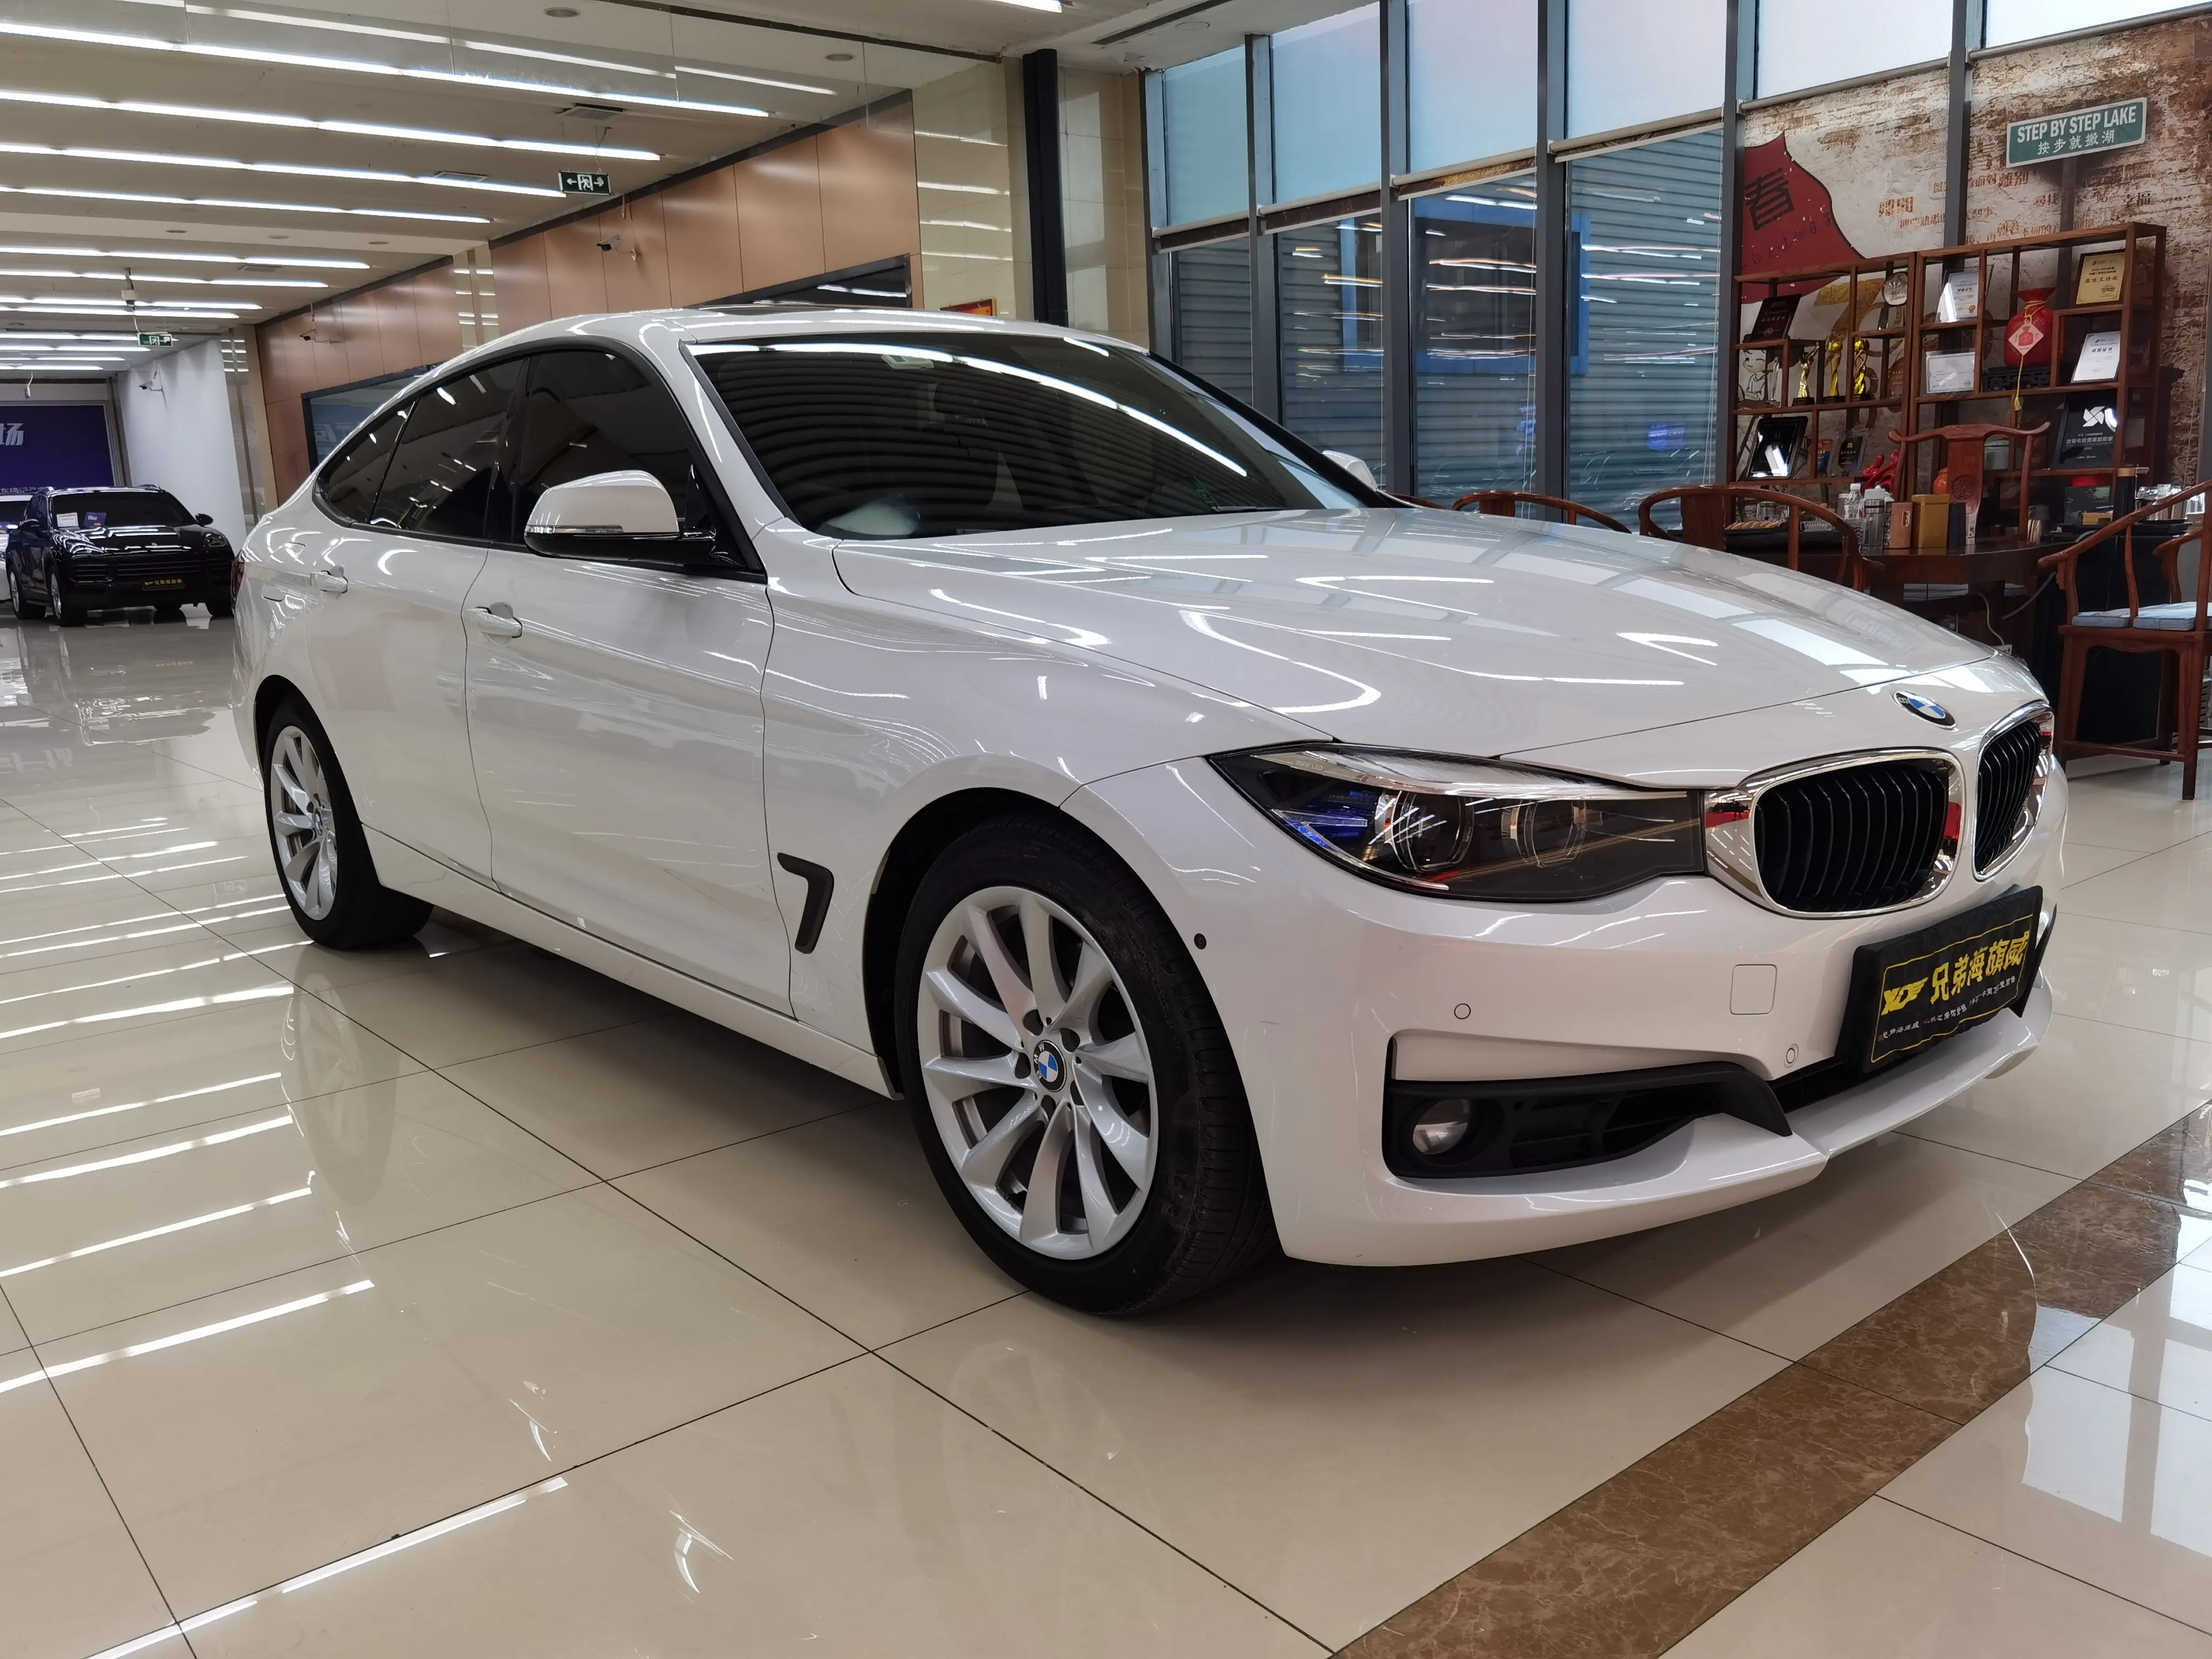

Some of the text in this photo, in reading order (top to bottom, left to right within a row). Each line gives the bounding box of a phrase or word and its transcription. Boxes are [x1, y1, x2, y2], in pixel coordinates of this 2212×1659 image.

[2017, 106, 2137, 143] STEP BY STEP LAKE
[2038, 129, 2115, 156] 按步就搬湖
[1744, 167, 1795, 231] 春
[1296, 760, 1311, 768] BMW
[1930, 930, 2031, 1005] 兄弟海旗威
